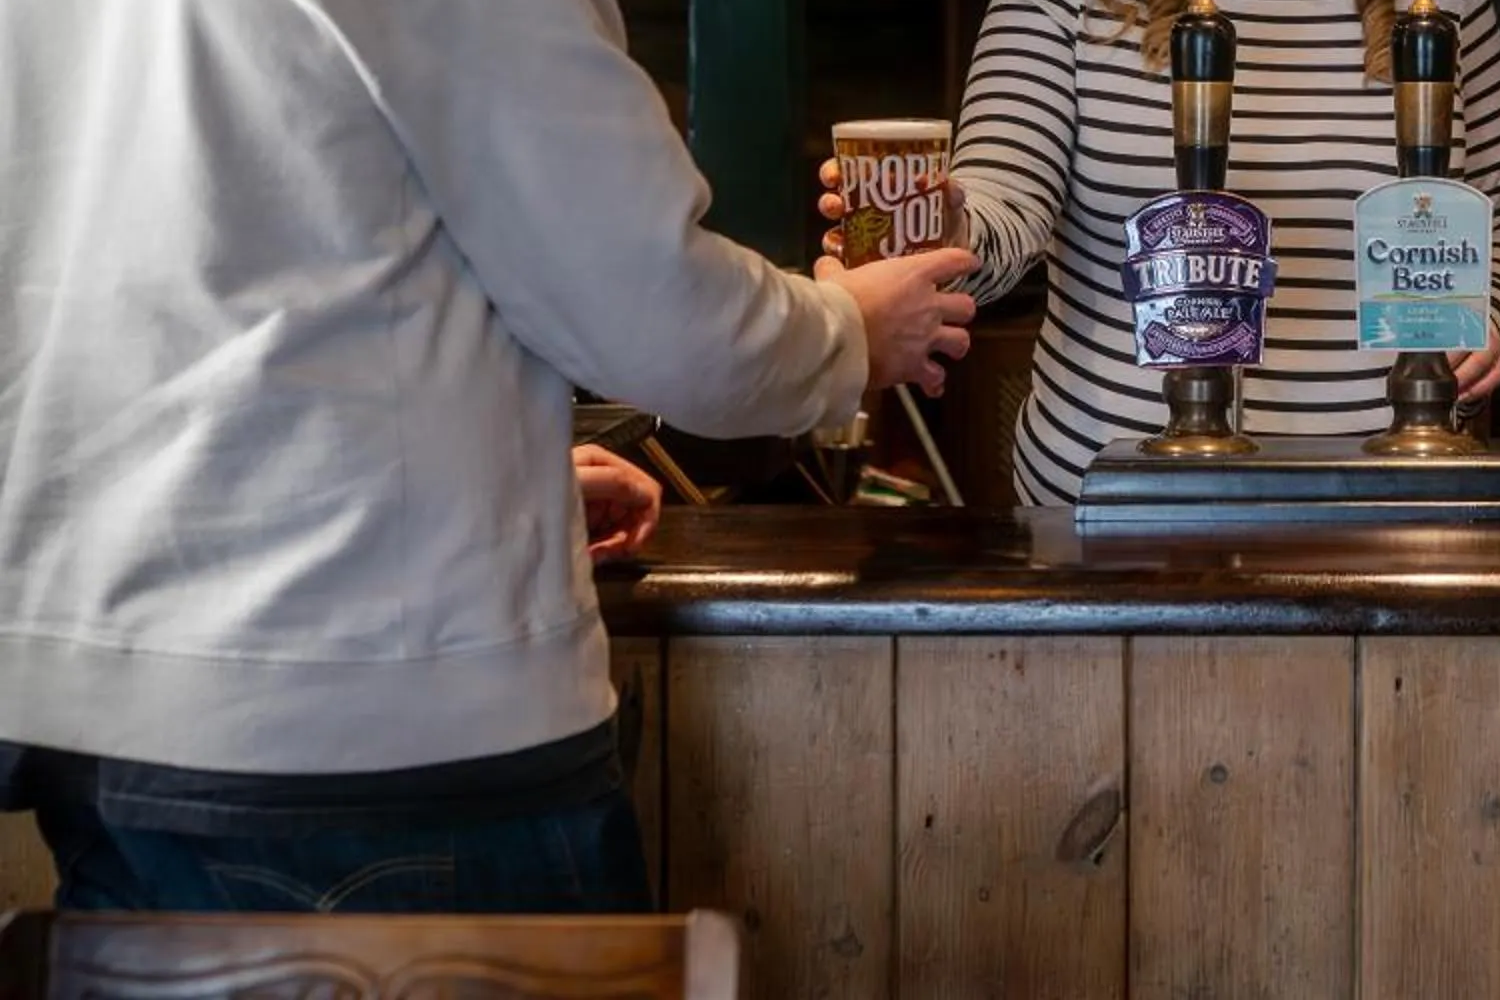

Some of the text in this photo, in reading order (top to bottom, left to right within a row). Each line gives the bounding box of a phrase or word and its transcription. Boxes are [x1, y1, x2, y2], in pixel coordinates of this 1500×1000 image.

[879, 189, 944, 258] JOB
[1367, 238, 1480, 265] Cornish
[1132, 255, 1264, 290] TRIBUTE
[1391, 266, 1455, 291] Best
[1167, 307, 1231, 319] PALE ALE
